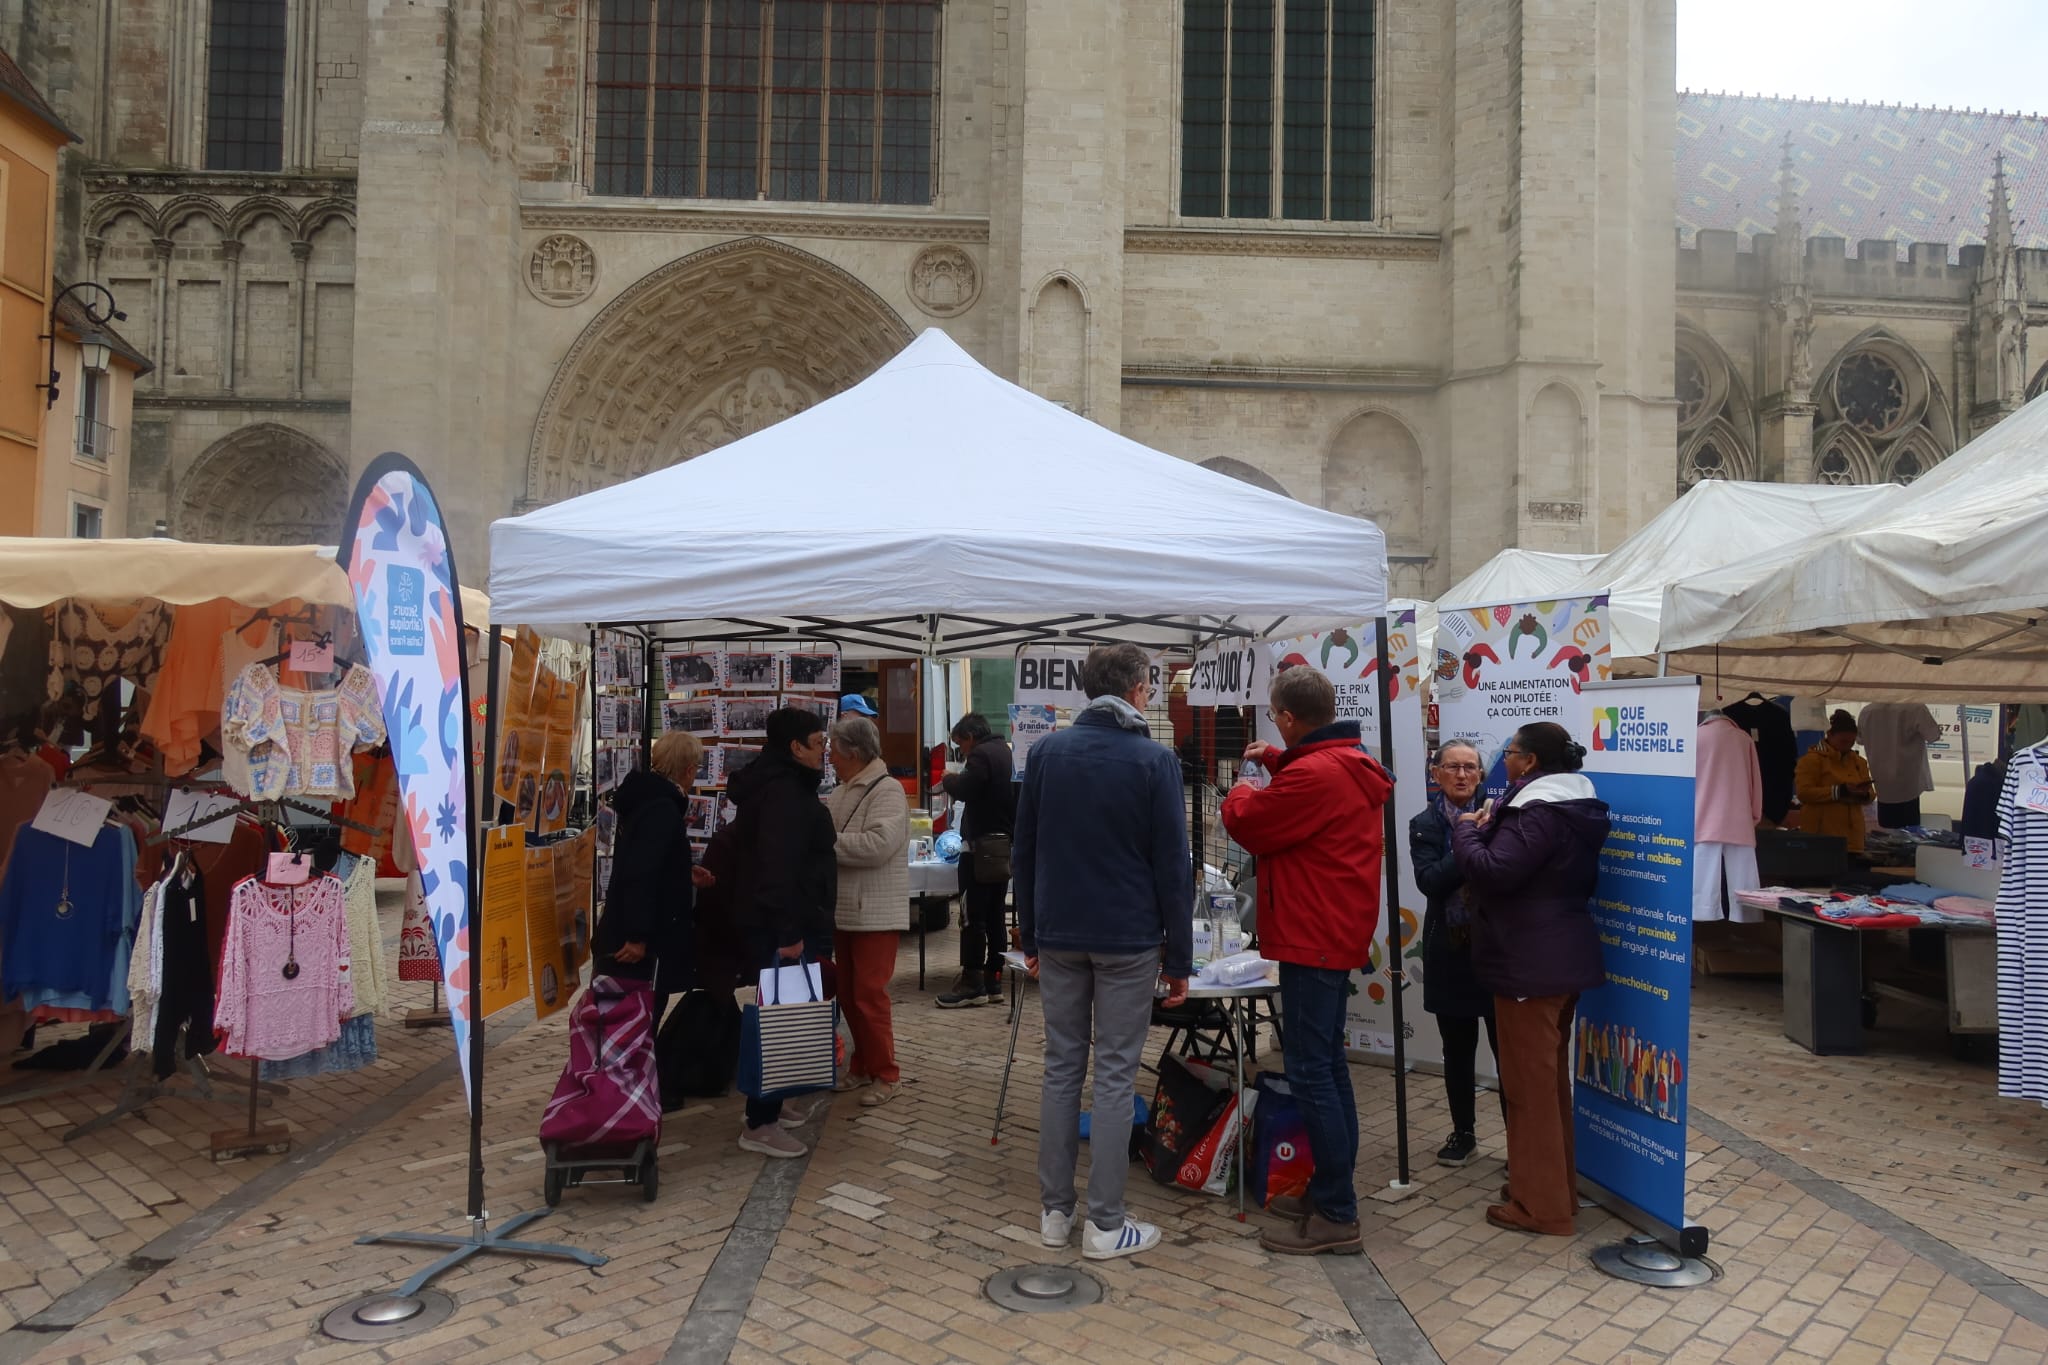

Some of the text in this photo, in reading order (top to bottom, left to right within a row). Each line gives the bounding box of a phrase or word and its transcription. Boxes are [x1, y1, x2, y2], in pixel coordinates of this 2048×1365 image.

[1019, 658, 1084, 691] BIEN
[1245, 648, 1255, 700] ?
[1334, 684, 1370, 694] TE PRIX
[1478, 678, 1570, 691] UNE ALIMENTATION
[1335, 696, 1358, 706] OTRE
[1490, 694, 1511, 704] NON
[1513, 692, 1552, 703] PILOTÉE
[1335, 707, 1373, 717] NTATION
[1487, 707, 1500, 720] ÇA
[1501, 705, 1531, 717] COÛTE
[1533, 706, 1559, 716] CHER
[1620, 706, 1645, 720] QUE
[1018, 721, 1049, 731] grandes
[1620, 722, 1668, 736] CHOISIR
[1619, 738, 1684, 752] ENSEMBLE
[1622, 813, 1662, 826] association
[1608, 828, 1687, 849] endante qui informe,
[1600, 847, 1682, 867] ompagne et mobilise
[1610, 866, 1667, 883] consommateurs.
[1598, 899, 1631, 913] expertise
[1633, 905, 1664, 921] nationale
[1666, 911, 1687, 925] forte
[1605, 918, 1625, 930] action
[1626, 922, 1636, 933] de
[1638, 925, 1677, 942] proximité
[1622, 940, 1649, 955] engagé
[1650, 947, 1658, 957] et
[1659, 949, 1686, 963] pluriel
[1605, 972, 1668, 1000] w.quechoisir.org
[1589, 1123, 1615, 1140] ACCESSIBLE
[1620, 1138, 1641, 1154] TOUTES
[1641, 1147, 1648, 1158] ET
[1650, 1151, 1665, 1166] TOUS
[1601, 1118, 1640, 1141] CONSOMMATION
[1641, 1136, 1679, 1160] RESPONSABLE
